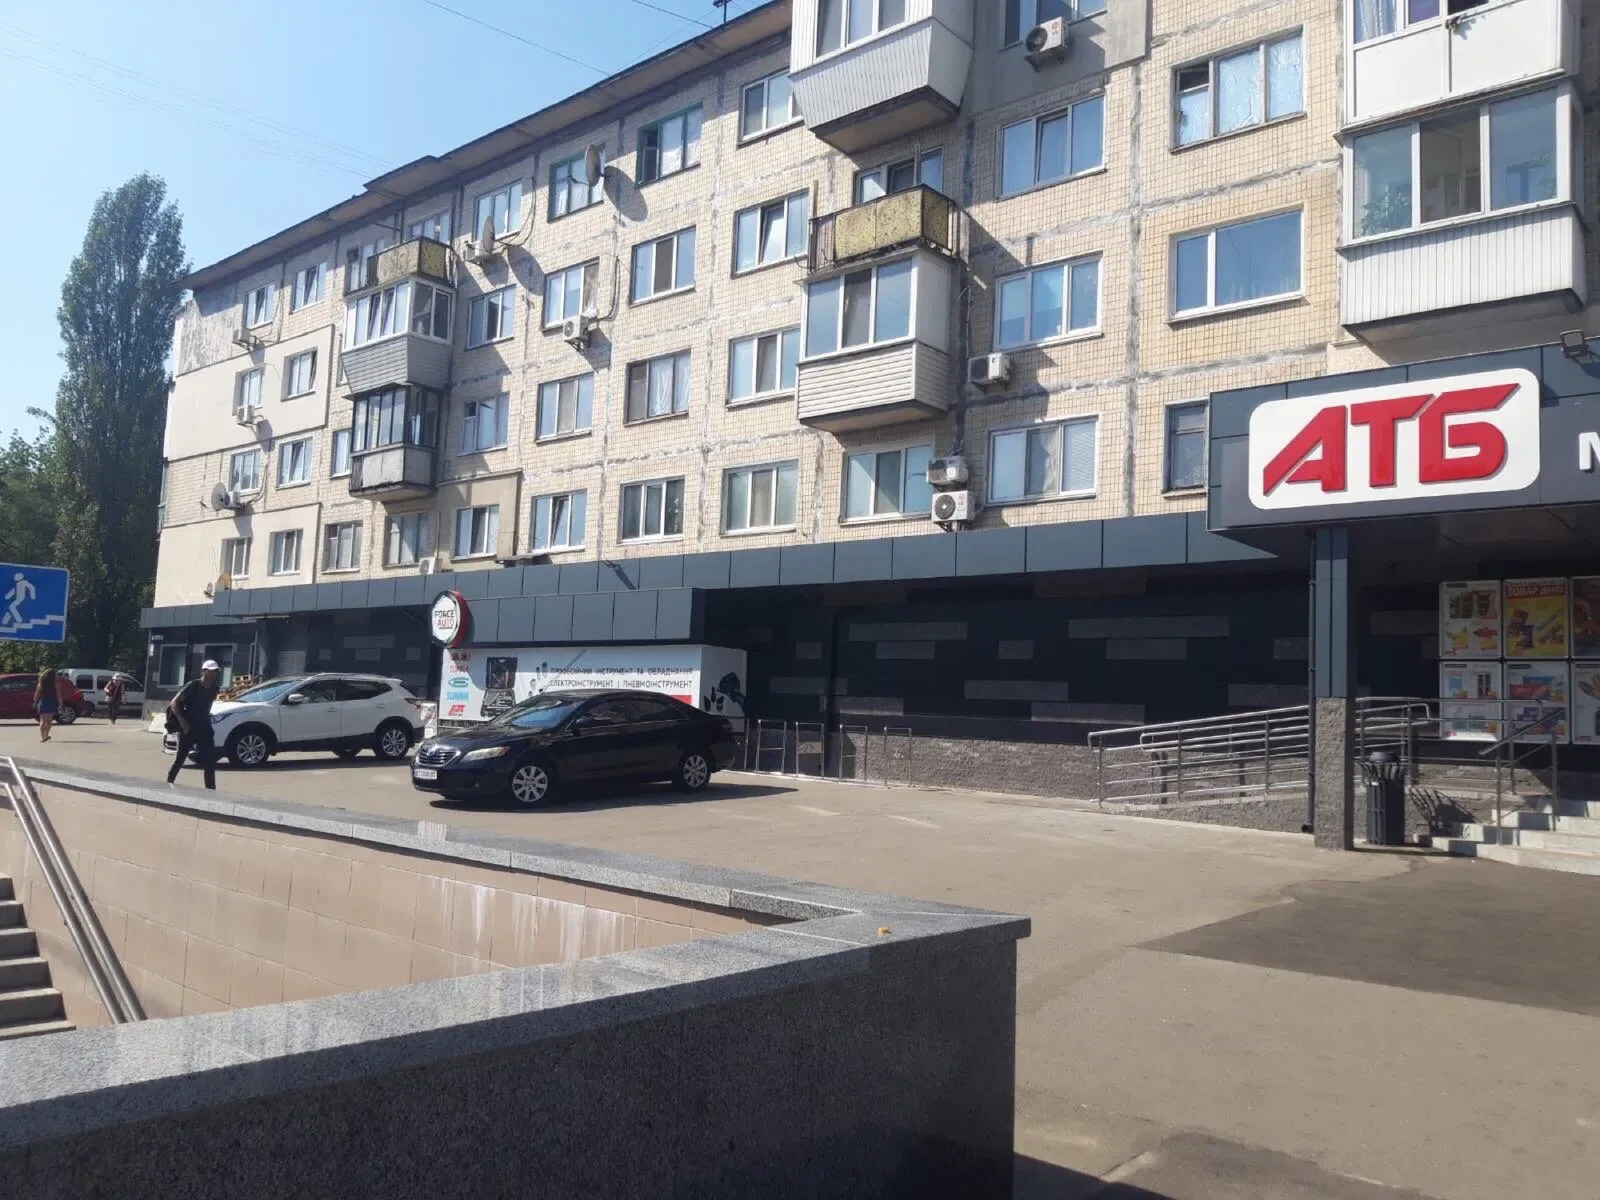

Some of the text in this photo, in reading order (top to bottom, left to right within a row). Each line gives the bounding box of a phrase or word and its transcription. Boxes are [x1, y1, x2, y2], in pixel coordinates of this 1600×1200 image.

[1263, 382, 1520, 497] АТБ
[435, 609, 455, 618] FORCE
[437, 618, 455, 627] AUTO
[550, 666, 592, 675] ПРОФЕСІЙНИЙ
[596, 667, 633, 675] ІНСТРУМЕНТ
[648, 667, 693, 675] ОБЛАДНАННЯ
[550, 679, 692, 688] ЕЛЕКТРОІНСТРУМЕНТ ПНЕВМОІНСТРУМЕНТ
